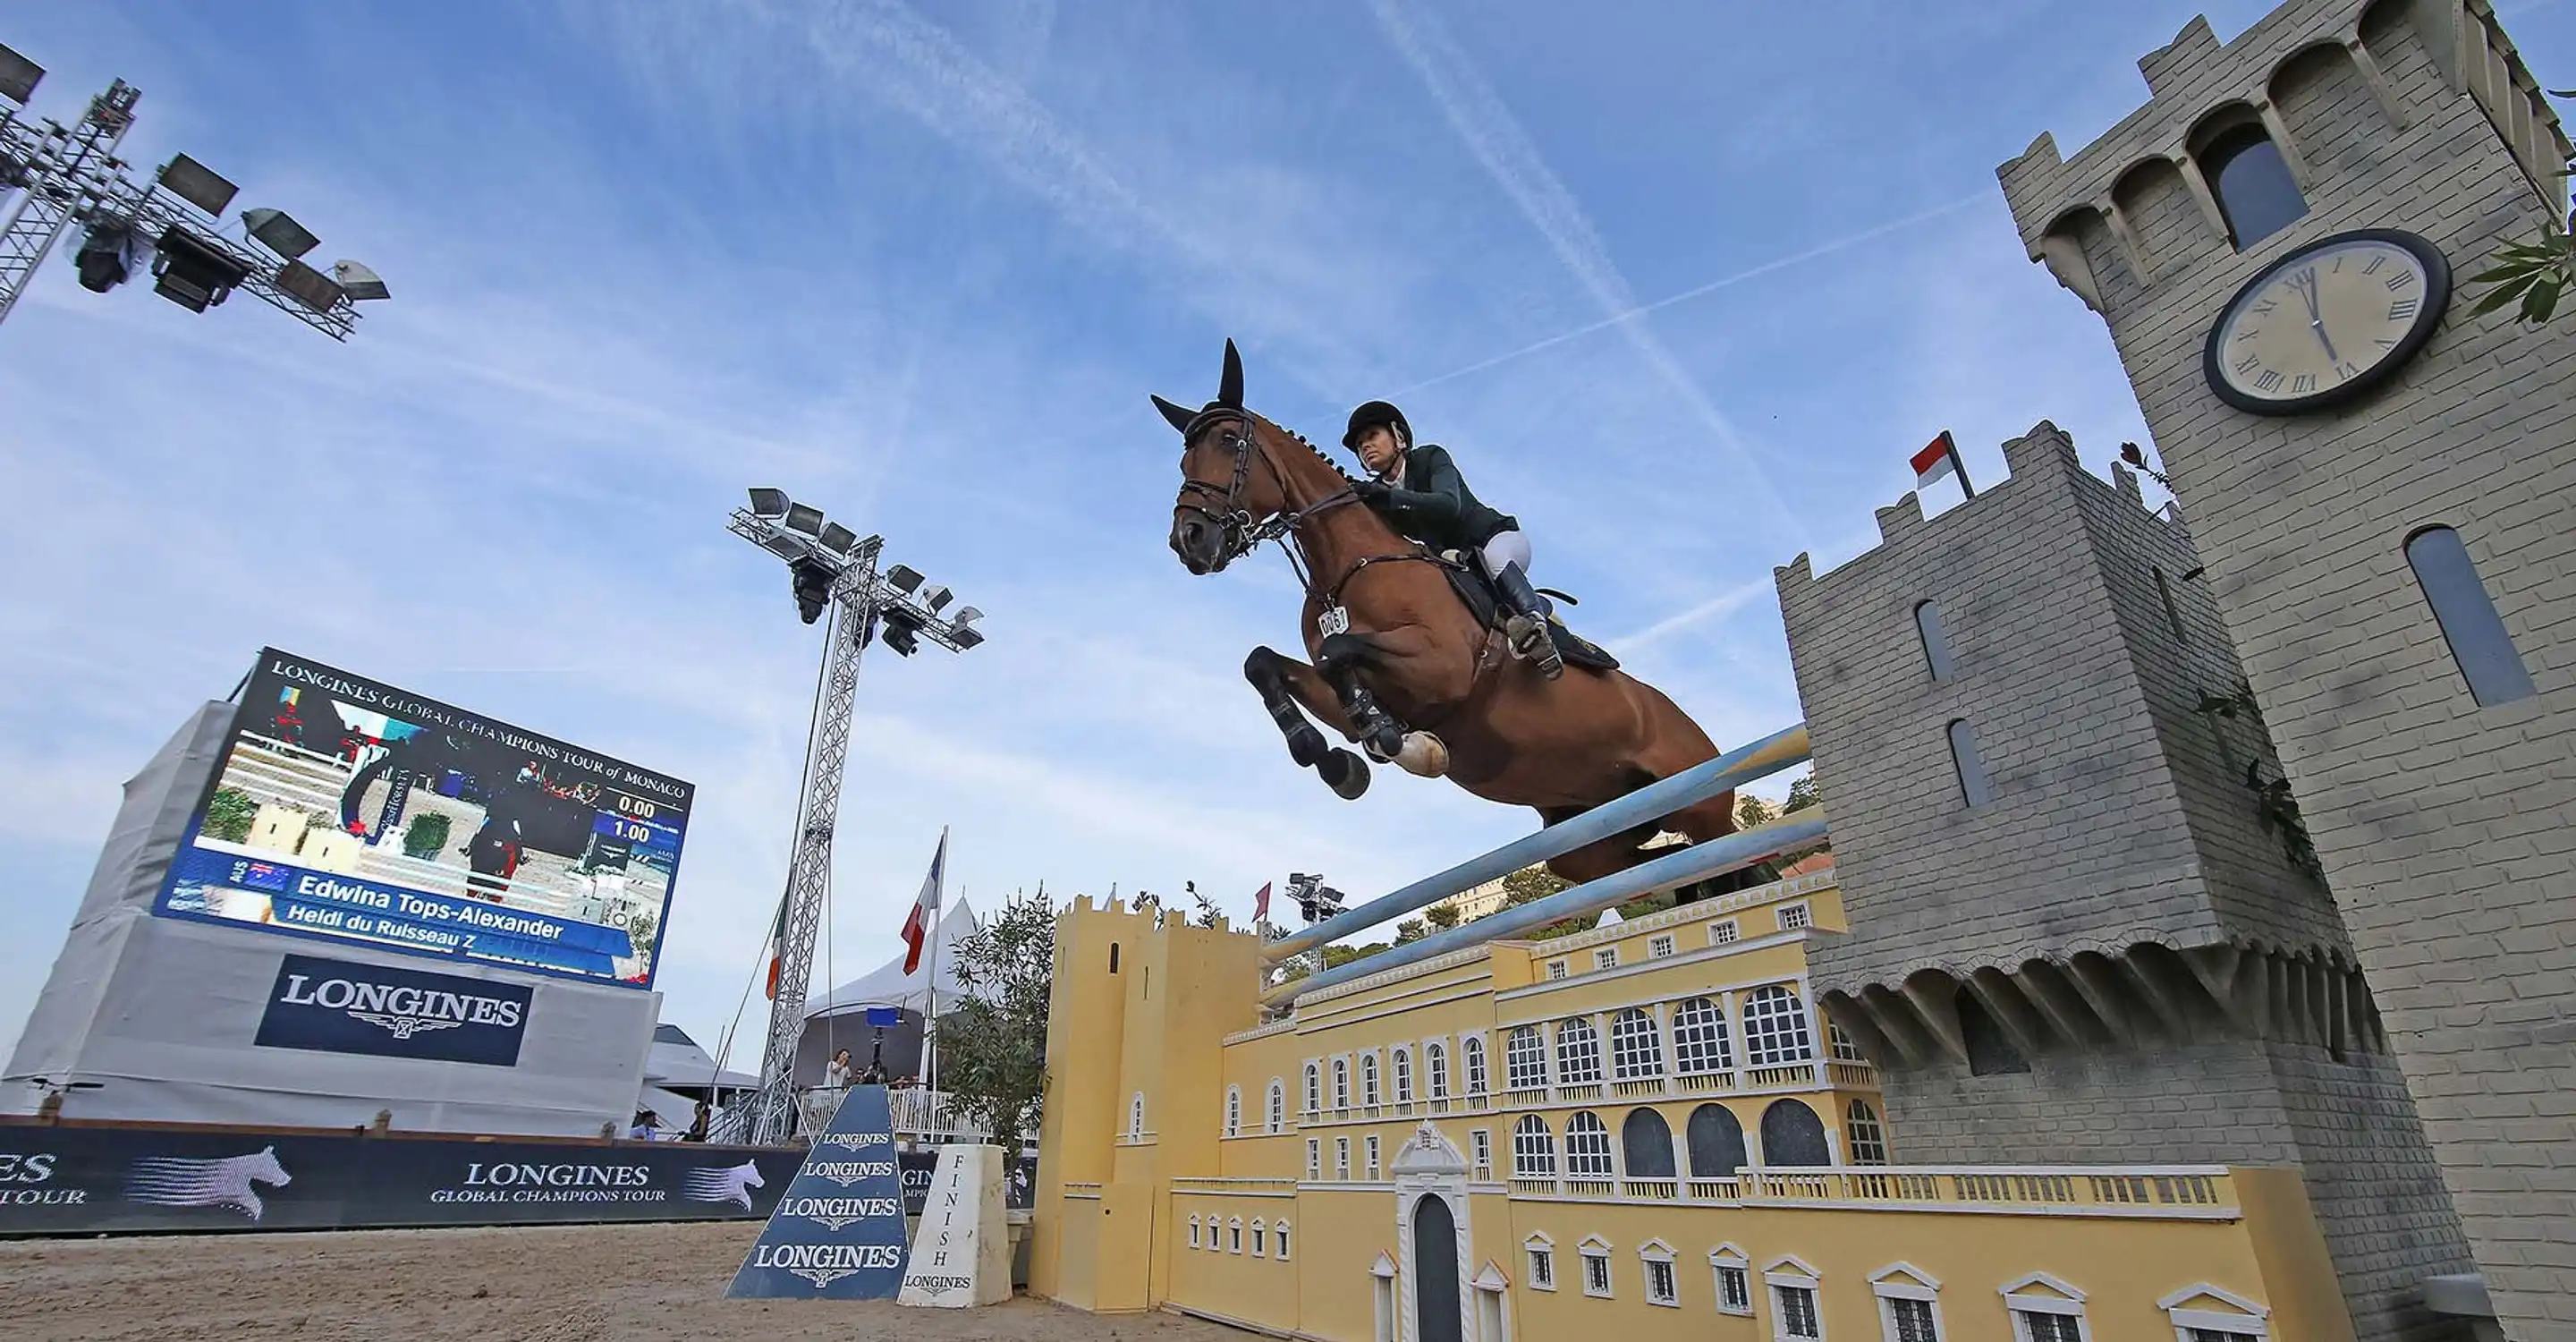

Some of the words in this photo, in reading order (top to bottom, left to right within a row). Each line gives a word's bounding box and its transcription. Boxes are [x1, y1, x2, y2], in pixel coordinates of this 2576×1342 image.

[2361, 256, 2386, 275] II
[2385, 270, 2414, 292] III
[272, 660, 379, 703] LONGINES
[382, 695, 454, 726] GLOBAL
[458, 718, 559, 760] CHAMPIONS
[563, 751, 606, 774] TOUR
[606, 767, 622, 779] of
[624, 771, 685, 799] MONACO
[618, 795, 655, 818] 0.00
[614, 821, 649, 843] 1.00
[229, 861, 250, 884] AUS
[297, 875, 390, 909] Edwina
[398, 893, 564, 940] Tops-Alexander
[286, 905, 344, 927] Heidi
[346, 914, 373, 932] du
[376, 920, 460, 947] Ruisseau
[459, 934, 477, 949] Z
[280, 974, 521, 1027] LONGINES
[823, 1133, 890, 1144] LONGINES
[463, 1163, 649, 1186] LONGINES
[804, 1162, 894, 1176] LONGINES
[0, 1188, 88, 1205] TOUR
[429, 1189, 508, 1203] GLOBAL
[513, 1189, 620, 1202] CHAMPIONS
[623, 1189, 666, 1202] TOUR
[782, 1198, 898, 1217] LONGINES
[933, 1154, 965, 1266] FINISH
[754, 1244, 902, 1269] LONGINES
[904, 1275, 970, 1288] LONGINES
